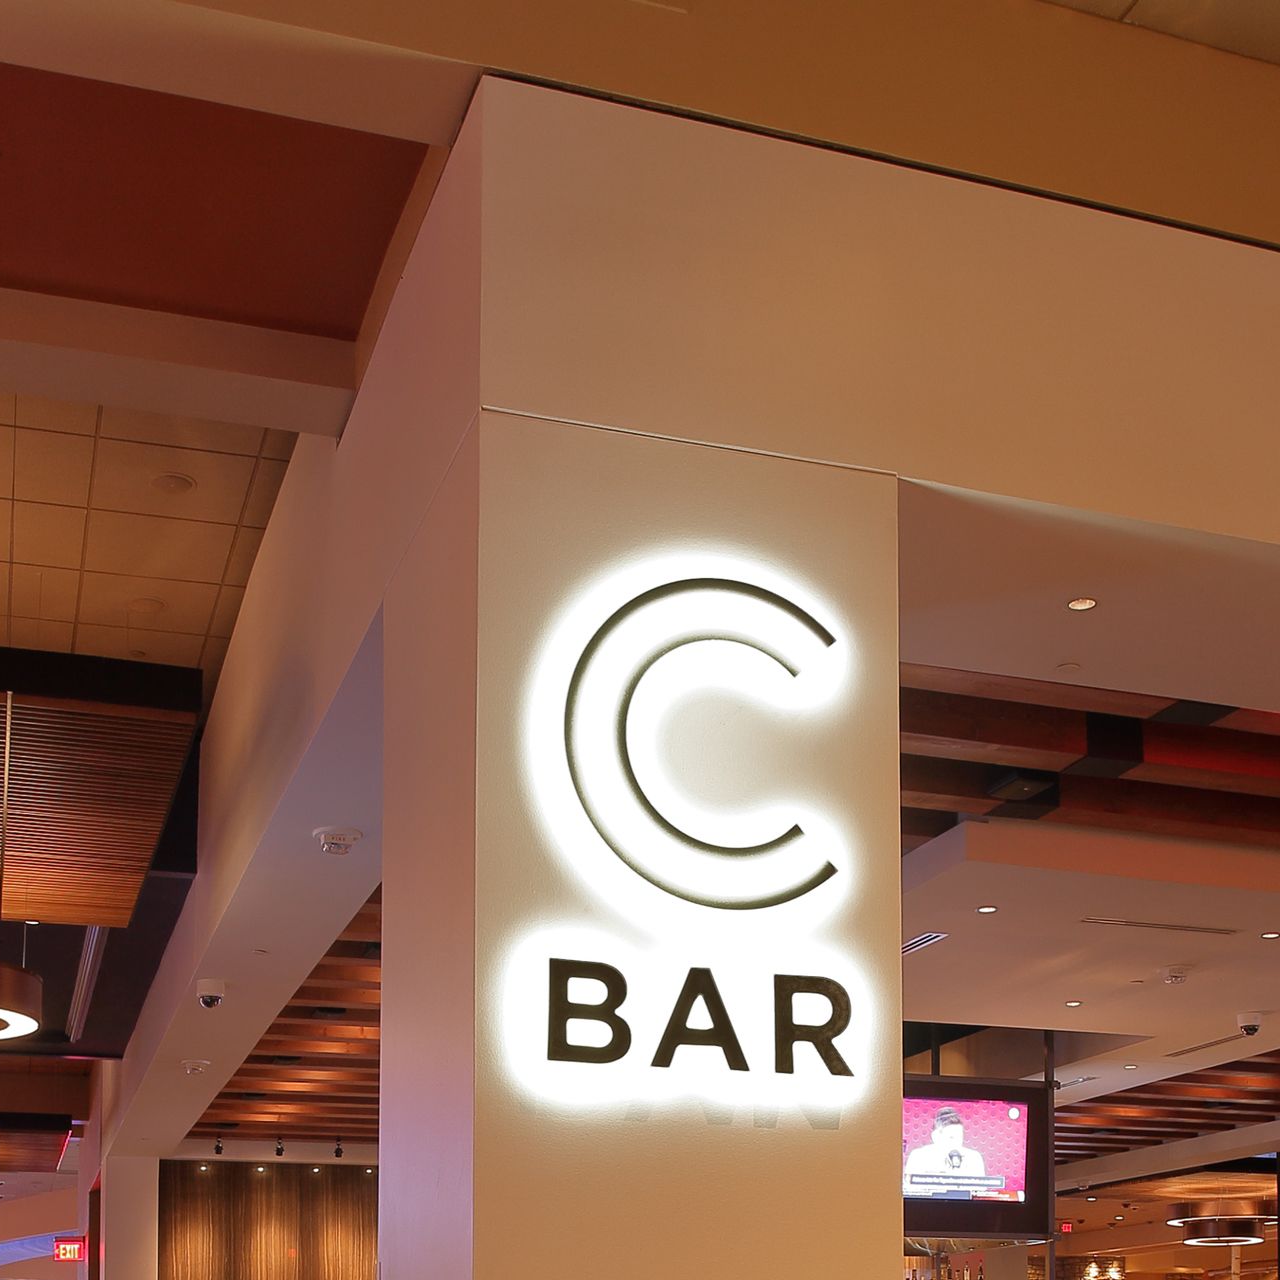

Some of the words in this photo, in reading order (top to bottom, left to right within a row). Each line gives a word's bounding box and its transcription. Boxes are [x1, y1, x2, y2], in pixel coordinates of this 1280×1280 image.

[564, 578, 838, 910] C
[547, 957, 854, 1078] BAR
[59, 1244, 80, 1259] EXIT
